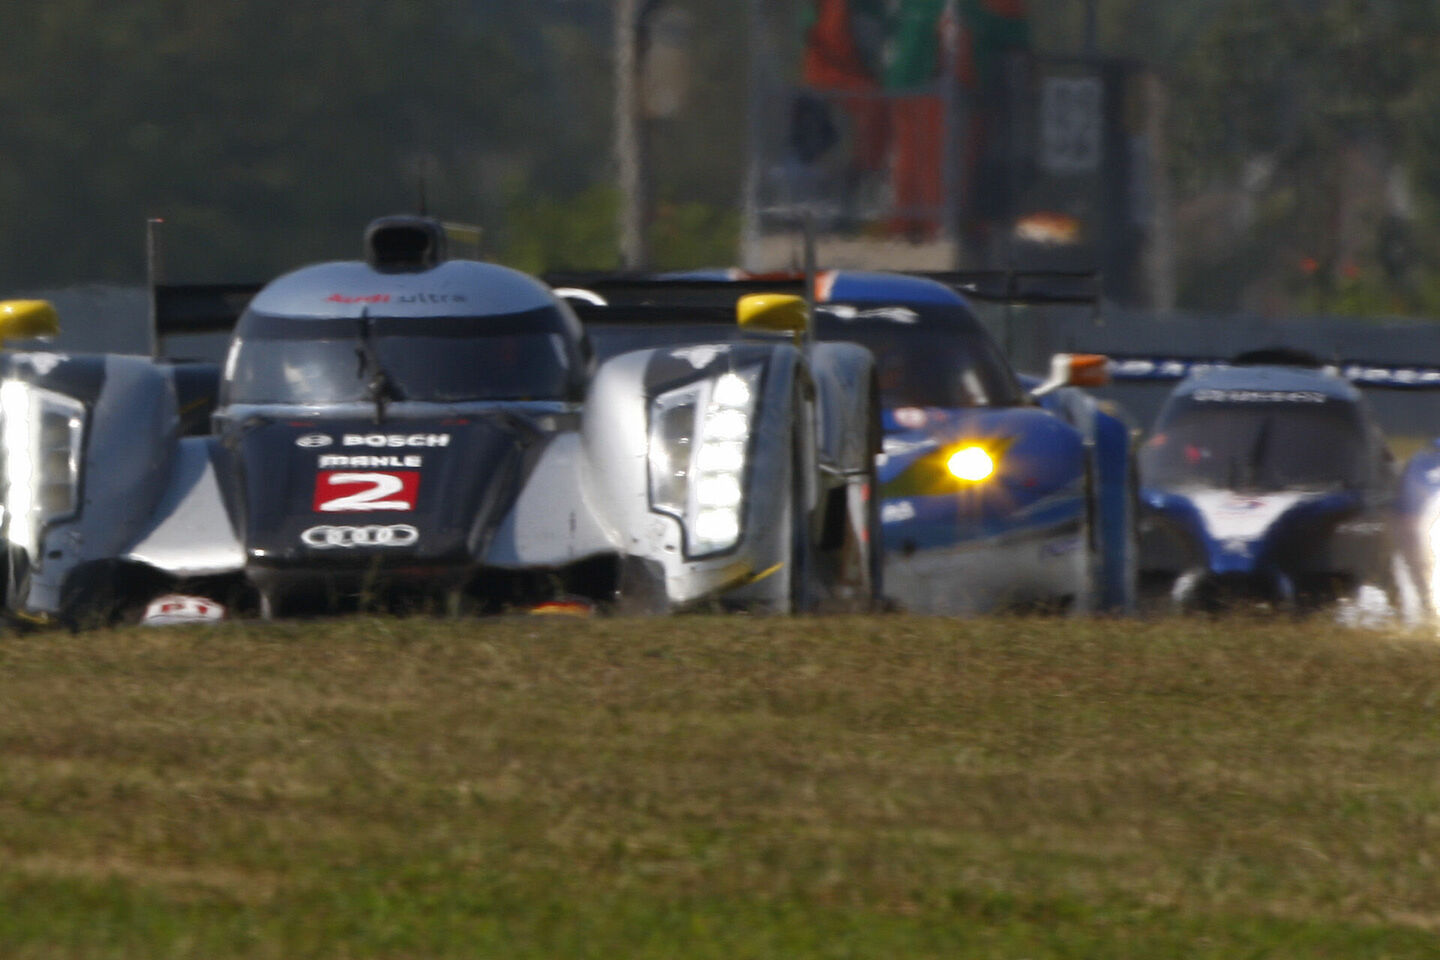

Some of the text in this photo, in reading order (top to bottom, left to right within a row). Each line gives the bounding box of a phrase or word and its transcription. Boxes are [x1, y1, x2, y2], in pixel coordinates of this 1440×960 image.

[326, 292, 468, 304] Audi ultra
[342, 433, 451, 448] BOSCH
[318, 454, 423, 469] MAHLE
[319, 472, 411, 512] 2
